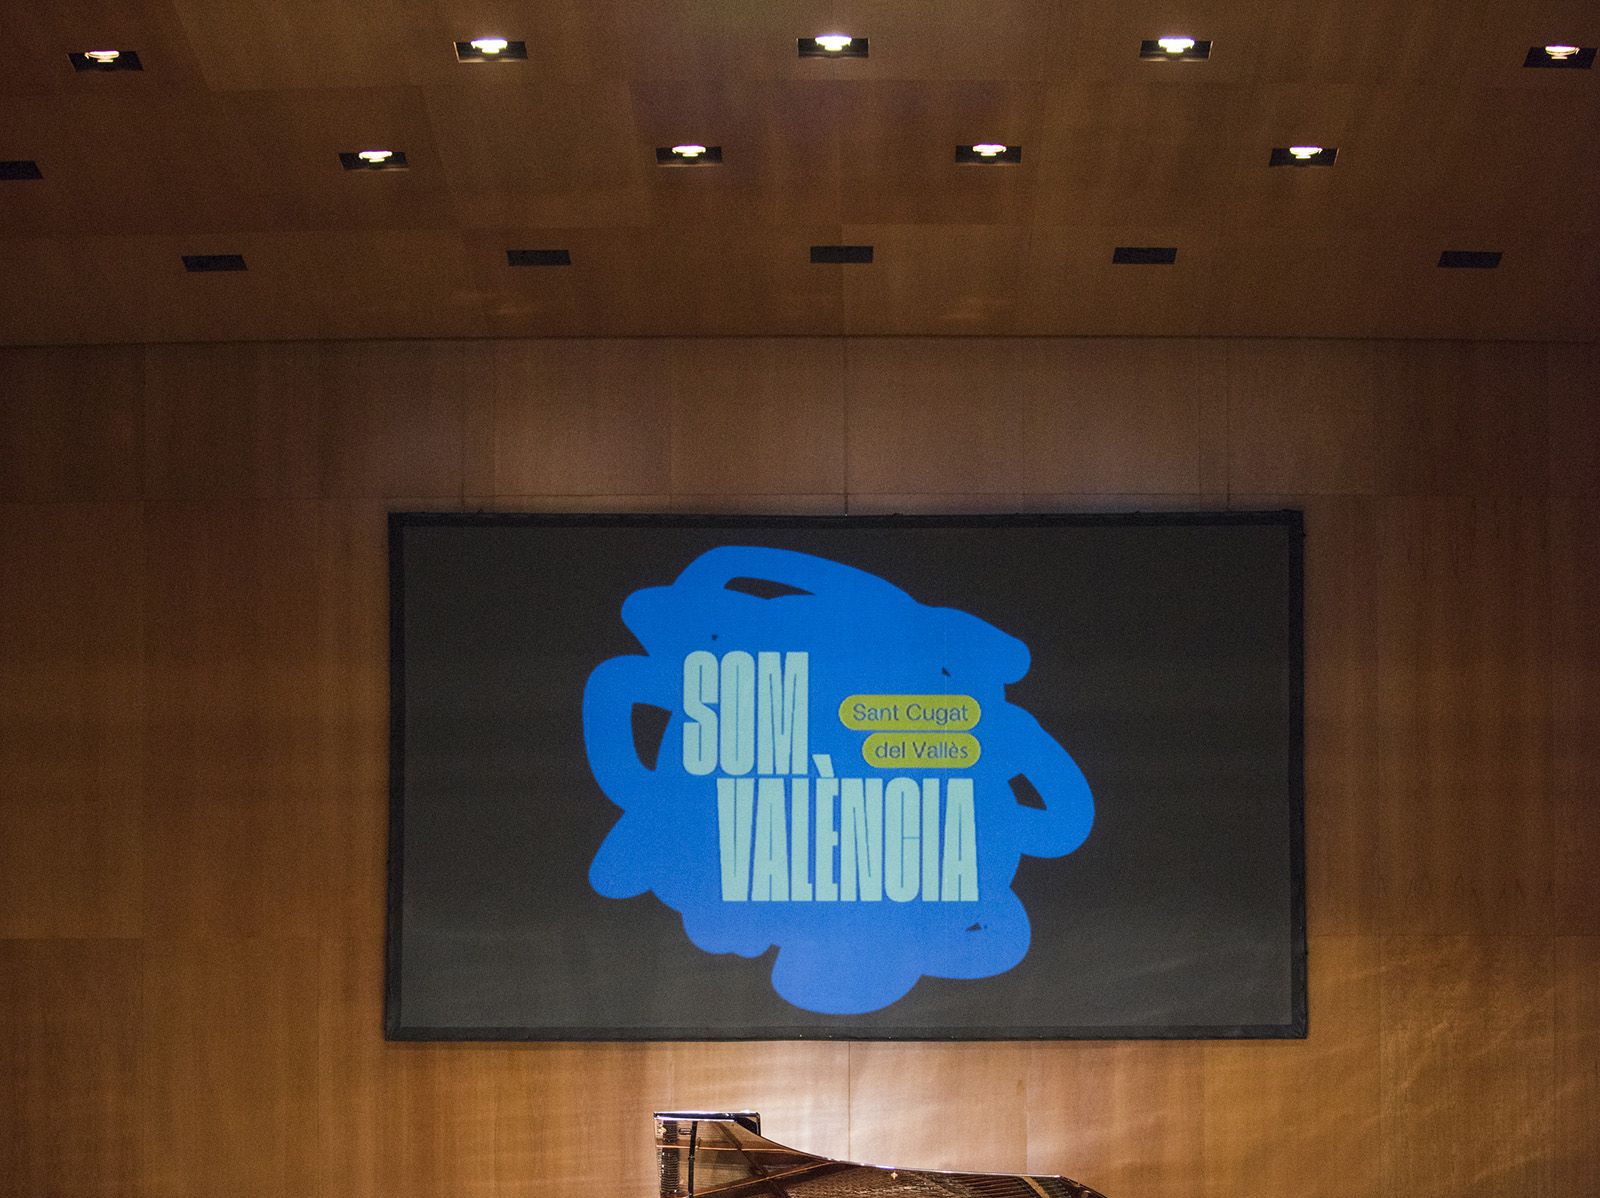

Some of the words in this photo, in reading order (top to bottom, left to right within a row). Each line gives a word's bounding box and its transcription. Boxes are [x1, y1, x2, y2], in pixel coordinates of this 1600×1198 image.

[682, 650, 809, 776] SOM
[853, 703, 899, 722] Sant
[906, 703, 969, 726] Cugat
[874, 743, 906, 759] del
[912, 743, 969, 759] Vallès
[716, 753, 979, 902] VALÈNCIA
